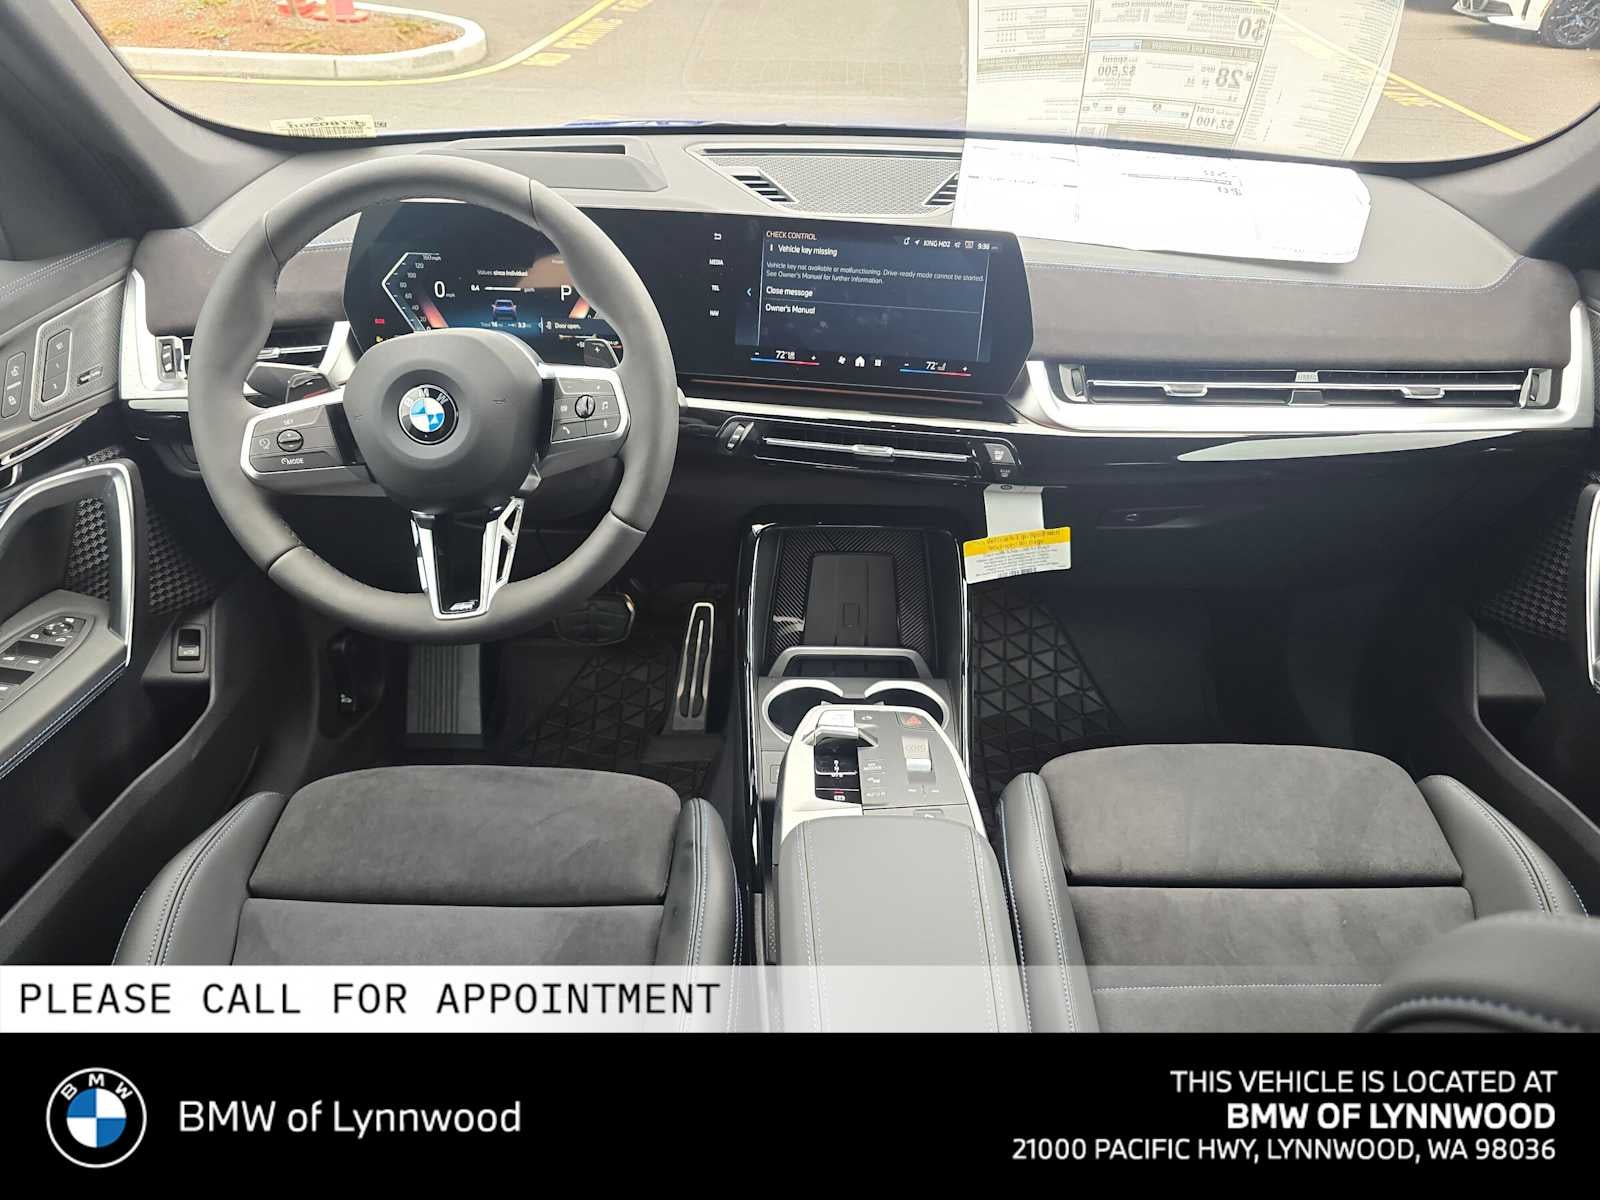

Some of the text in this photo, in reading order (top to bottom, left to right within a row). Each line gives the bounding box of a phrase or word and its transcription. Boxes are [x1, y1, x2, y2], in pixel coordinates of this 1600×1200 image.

[766, 231, 817, 240] CHECK CONTROL
[778, 244, 838, 257] Vehicle key missing
[766, 261, 786, 269] Vehicle
[787, 263, 797, 271] key
[779, 271, 801, 279] Owner's
[802, 272, 822, 280] Manual
[823, 273, 831, 281] for
[434, 280, 446, 298] 0
[560, 285, 572, 301] P
[766, 286, 813, 298] Close message
[765, 304, 816, 315] Owner's Manual
